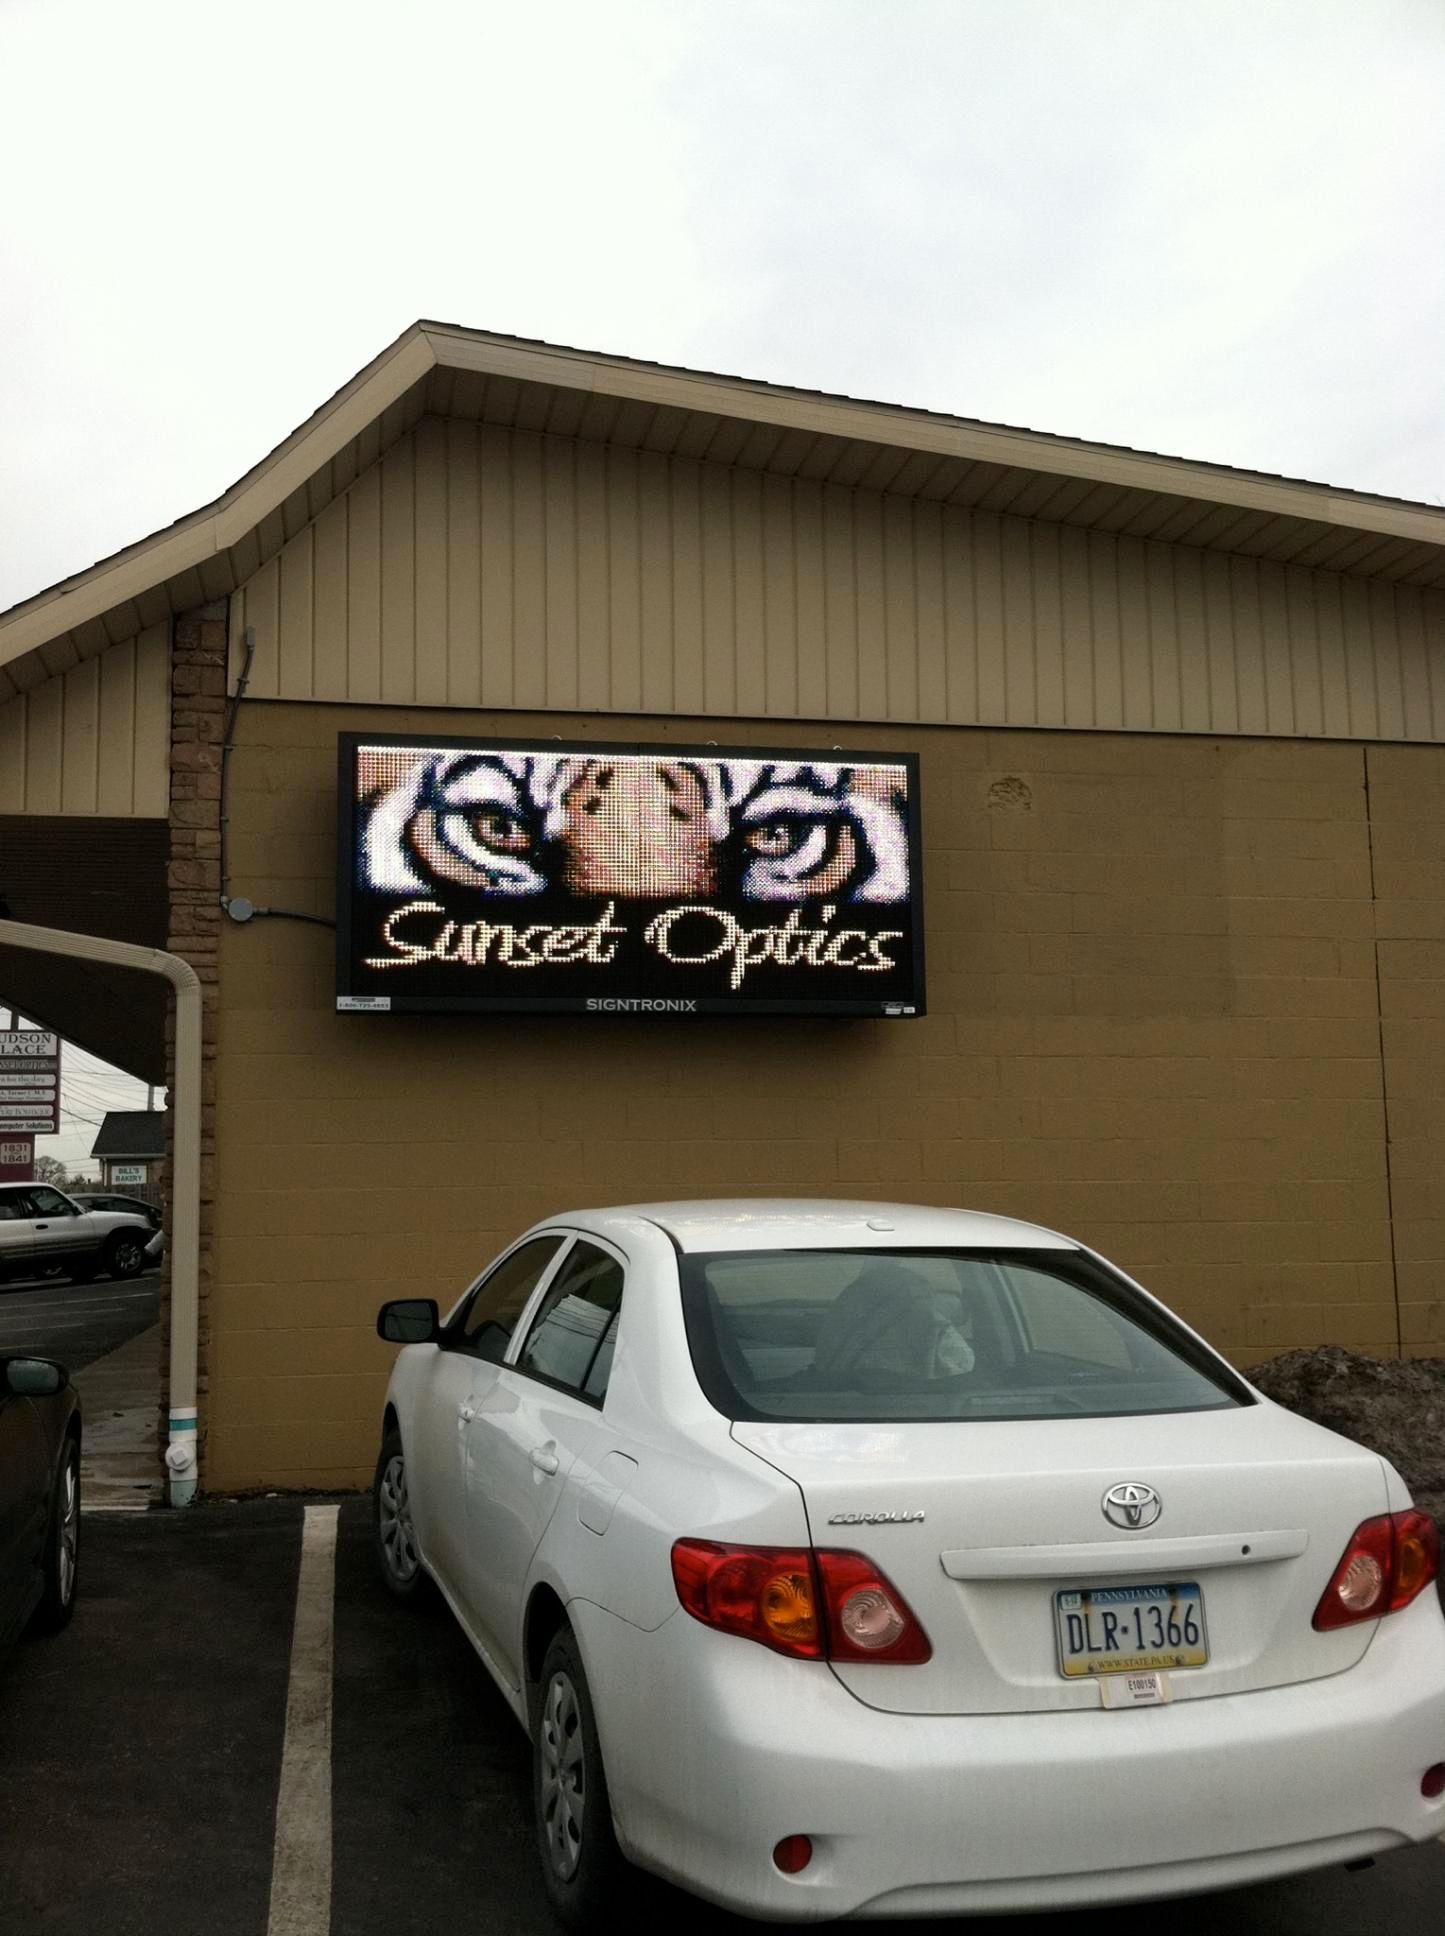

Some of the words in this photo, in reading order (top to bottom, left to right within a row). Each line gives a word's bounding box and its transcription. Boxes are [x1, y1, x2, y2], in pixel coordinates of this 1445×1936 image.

[364, 900, 628, 968] Sunset
[644, 905, 904, 990] Optics
[586, 999, 697, 1012] SIGNTRONIX
[3, 1154, 28, 1162] 1841
[118, 1167, 140, 1175] BILL'S
[828, 1510, 925, 1525] COROLLA
[1091, 1588, 1168, 1602] PENNSYLVANIA
